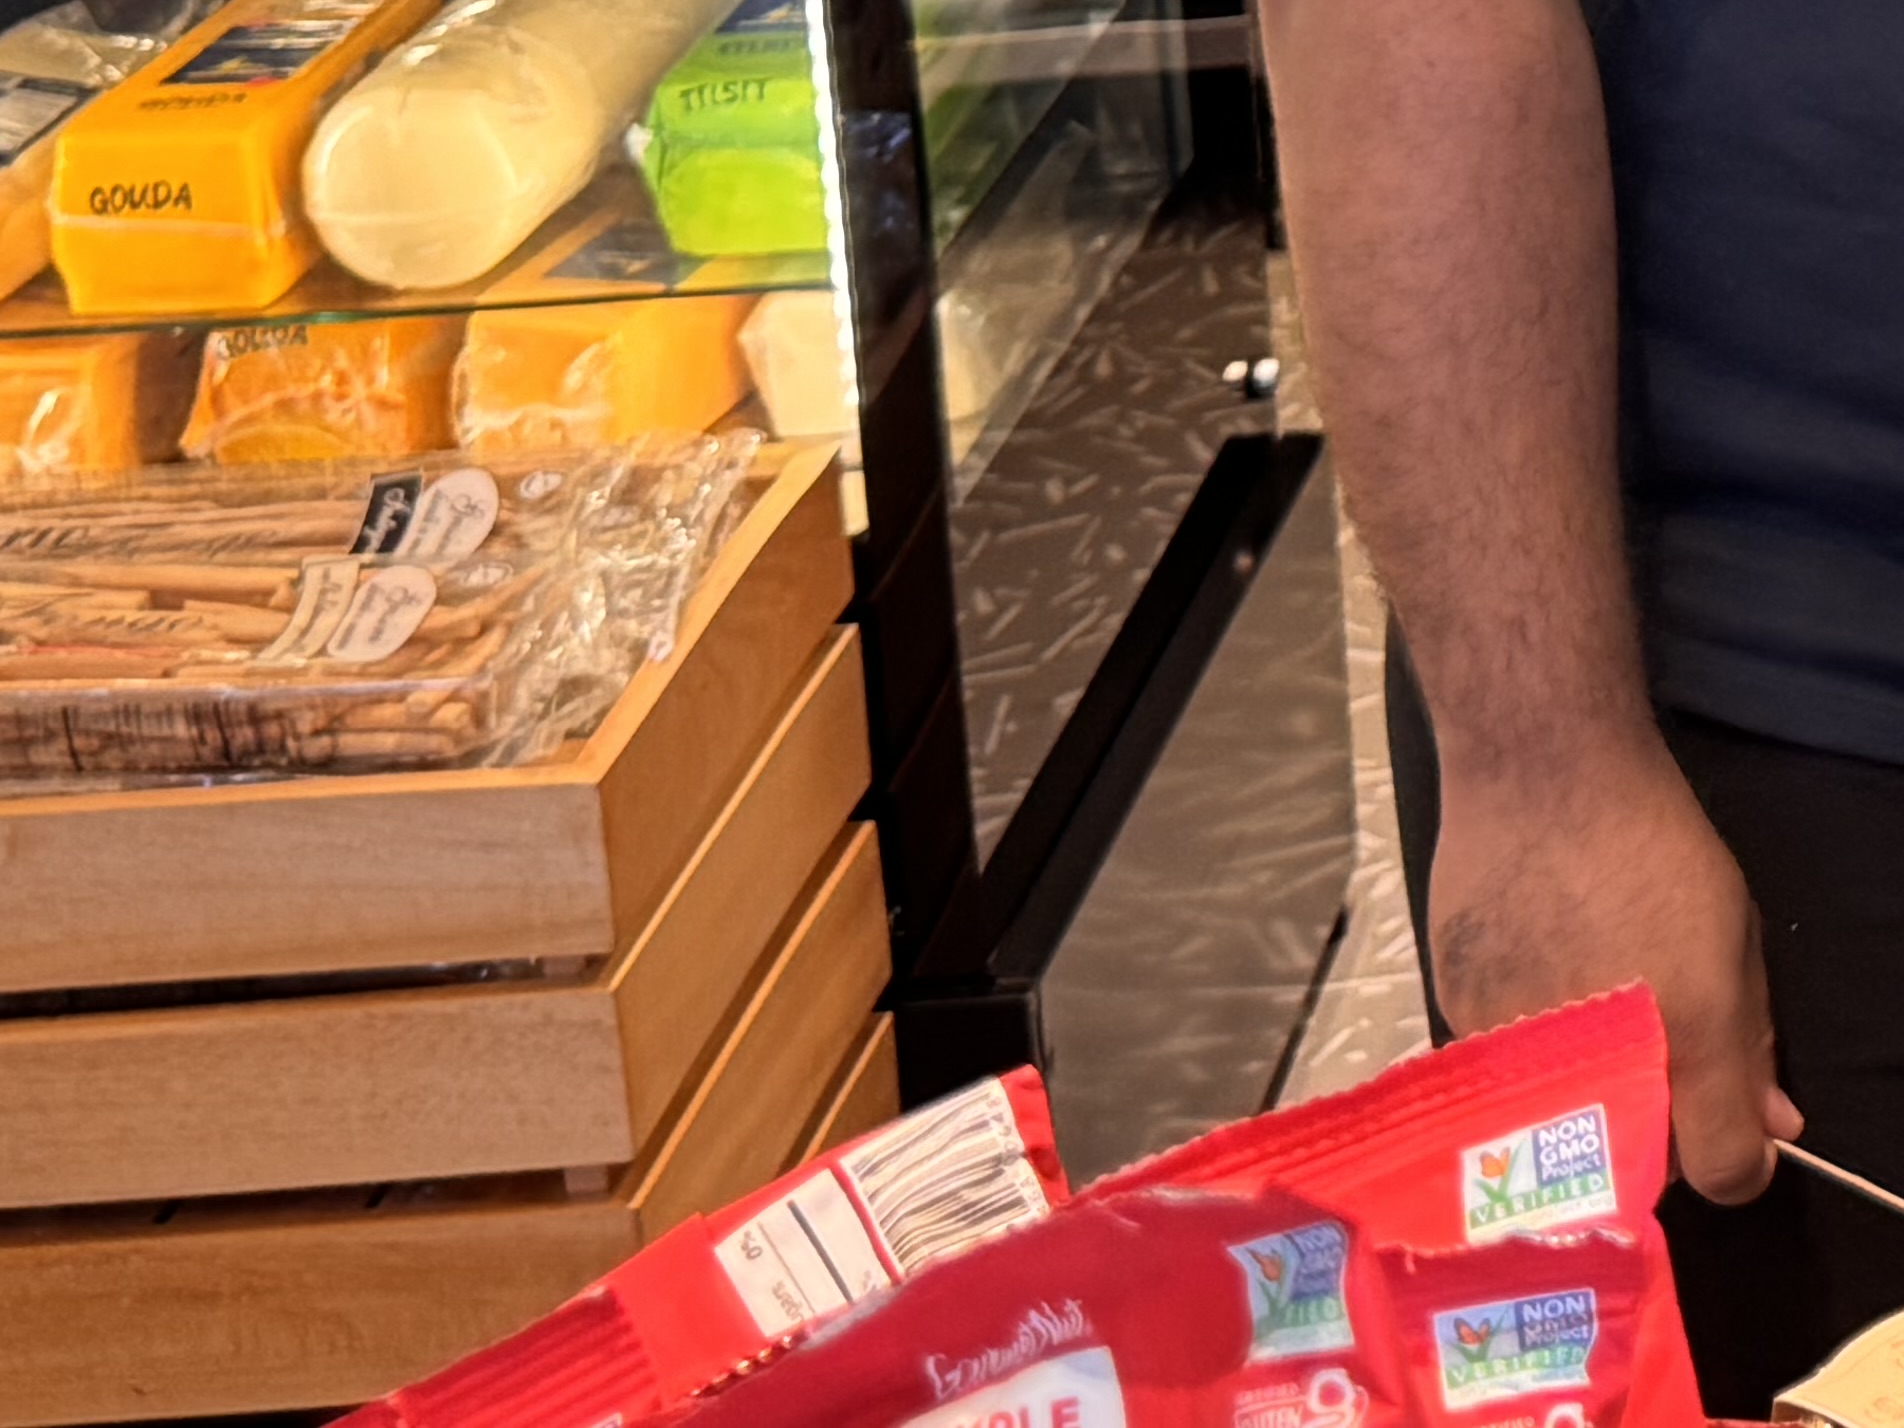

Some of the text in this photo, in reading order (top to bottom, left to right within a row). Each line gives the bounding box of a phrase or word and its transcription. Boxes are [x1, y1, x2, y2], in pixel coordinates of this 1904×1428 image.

[89, 180, 193, 215] GOUDA
[1537, 1114, 1598, 1148] NON
[1540, 1135, 1600, 1165] GMO
[1542, 1156, 1601, 1181] Project
[1475, 1175, 1605, 1226] VERIFIED
[1522, 1295, 1586, 1322] NON
[1448, 1346, 1586, 1383] VERIFIED
